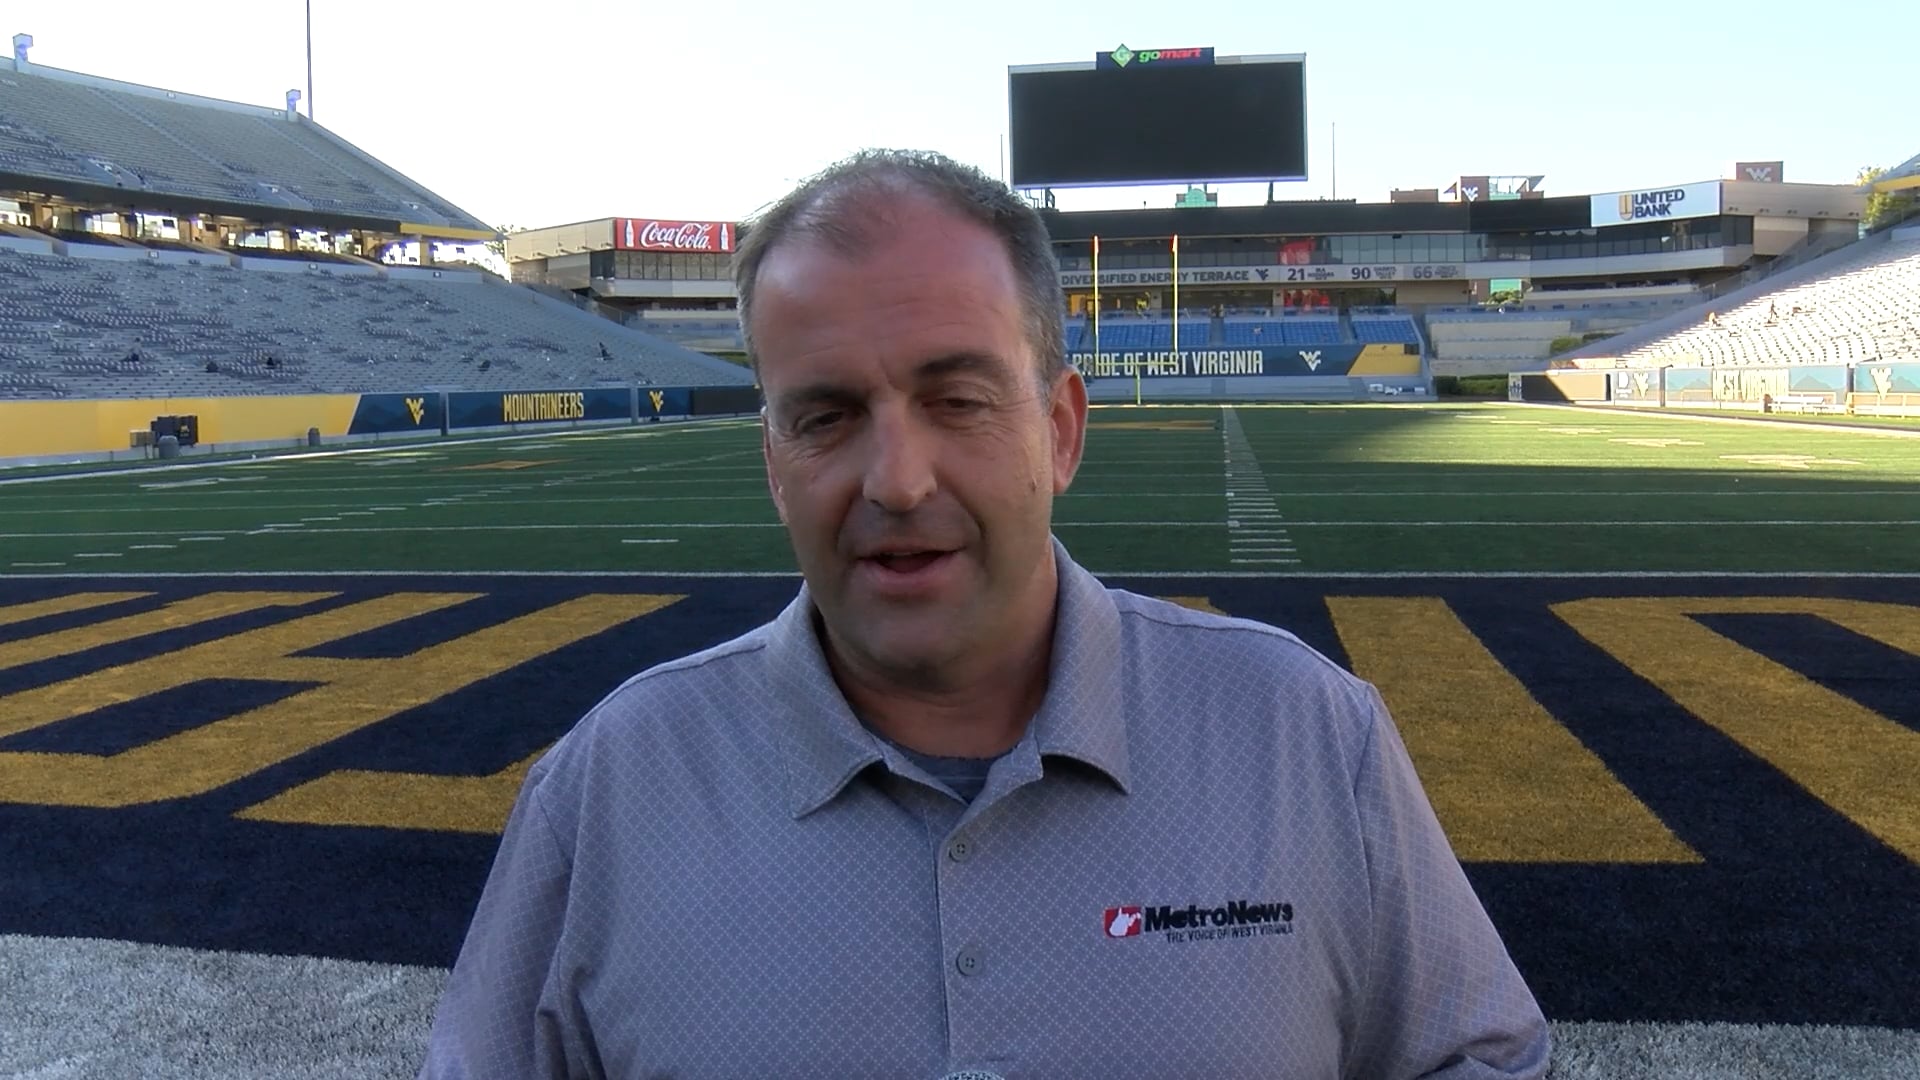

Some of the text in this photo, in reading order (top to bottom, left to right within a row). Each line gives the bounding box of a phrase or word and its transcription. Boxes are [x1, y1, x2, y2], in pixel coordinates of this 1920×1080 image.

[1139, 48, 1201, 62] gomart
[1634, 189, 1685, 205] UNITED
[1635, 203, 1671, 218] BANK
[640, 221, 714, 249] Coca-Cola
[1061, 273, 1137, 286] DIVESIFIED
[1140, 271, 1189, 283] ENERY
[1192, 270, 1249, 282] TERRACE
[1287, 268, 1305, 281] 21
[1351, 267, 1371, 280] 90
[1413, 266, 1432, 279] 66
[1072, 353, 1120, 377] PRIDE
[1124, 352, 1143, 376] OF
[1147, 351, 1189, 376] WEST
[1192, 349, 1263, 375] VIRGINIA
[503, 392, 585, 423] MOUNTAINEERS
[1144, 900, 1294, 933] MetroNews
[1166, 931, 1185, 944] THE
[1187, 929, 1215, 942] VOICE
[1216, 928, 1228, 940] OF
[1230, 925, 1257, 939] WEST
